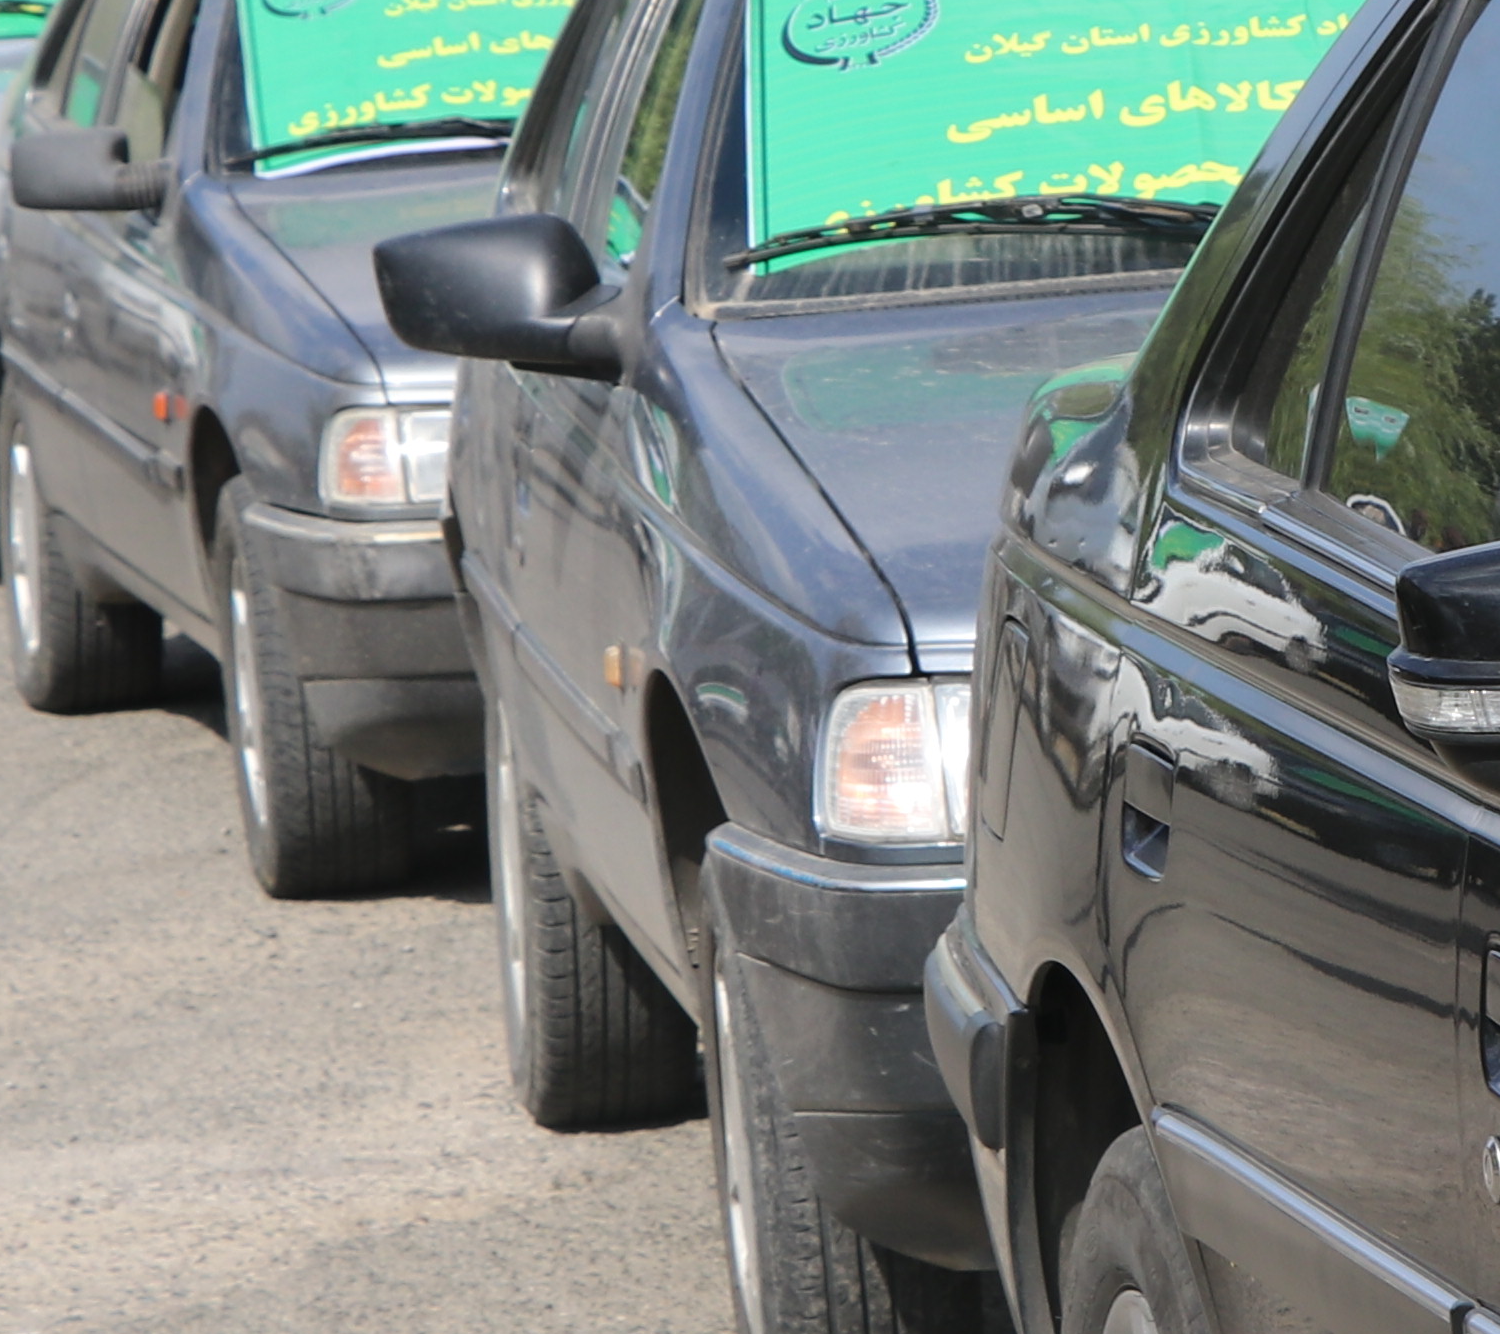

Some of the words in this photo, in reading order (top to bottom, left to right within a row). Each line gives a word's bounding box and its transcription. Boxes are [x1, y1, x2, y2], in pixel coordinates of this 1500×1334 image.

[806, 2, 911, 30] جهاد
[1160, 13, 1307, 47] کشاورزی
[377, 31, 481, 69] اساسی
[965, 32, 1051, 64] گیلان
[1061, 23, 1151, 55] استان
[288, 83, 432, 137] کشاورزی
[947, 89, 1105, 144] اساسی
